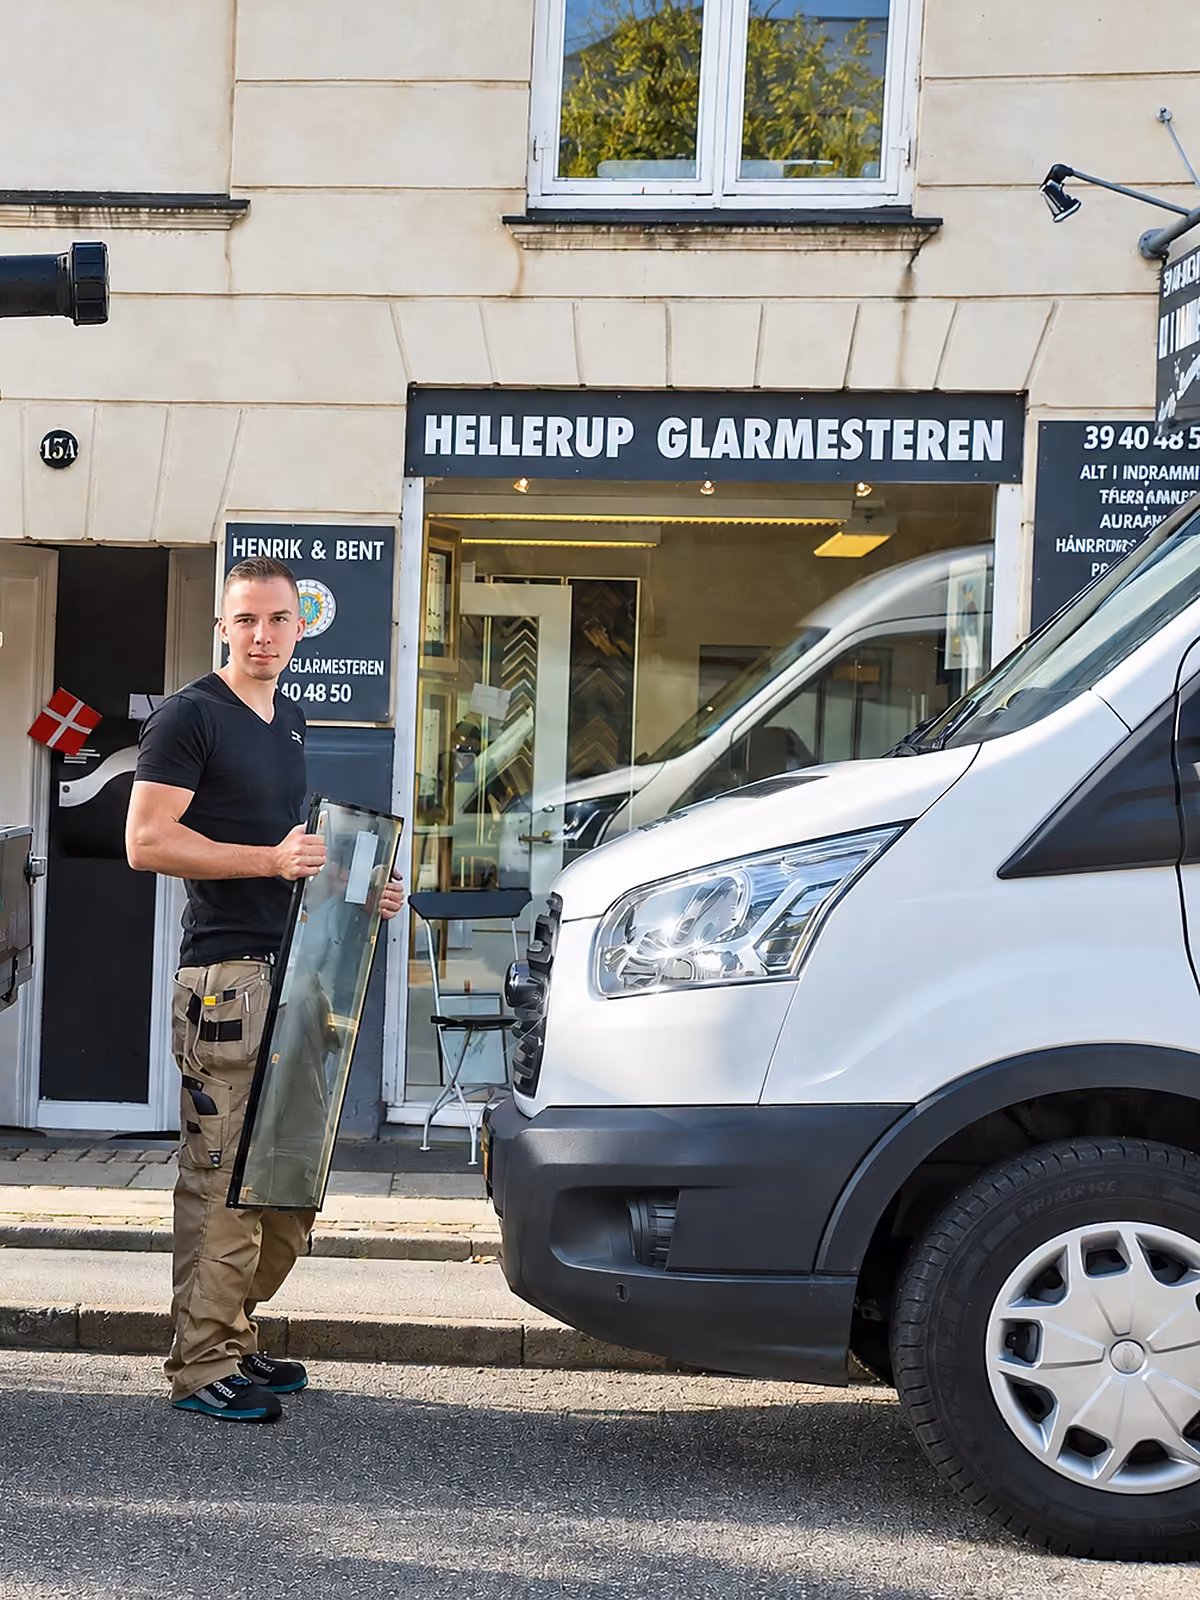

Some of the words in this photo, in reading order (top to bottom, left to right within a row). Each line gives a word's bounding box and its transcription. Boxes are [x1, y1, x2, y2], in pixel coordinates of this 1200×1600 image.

[424, 414, 635, 458] HELLERUP
[657, 416, 1004, 461] GLARMESTEREN
[1083, 425, 1115, 450] 39
[1118, 425, 1149, 450] 40
[1080, 465, 1108, 480] ALT
[1112, 465, 1118, 480] I
[232, 537, 303, 559] HENRIK
[311, 540, 327, 560] &
[335, 540, 384, 561] BENT
[289, 658, 384, 676] GLARMESTEREN
[303, 683, 327, 703] 48
[329, 684, 352, 703] 50
